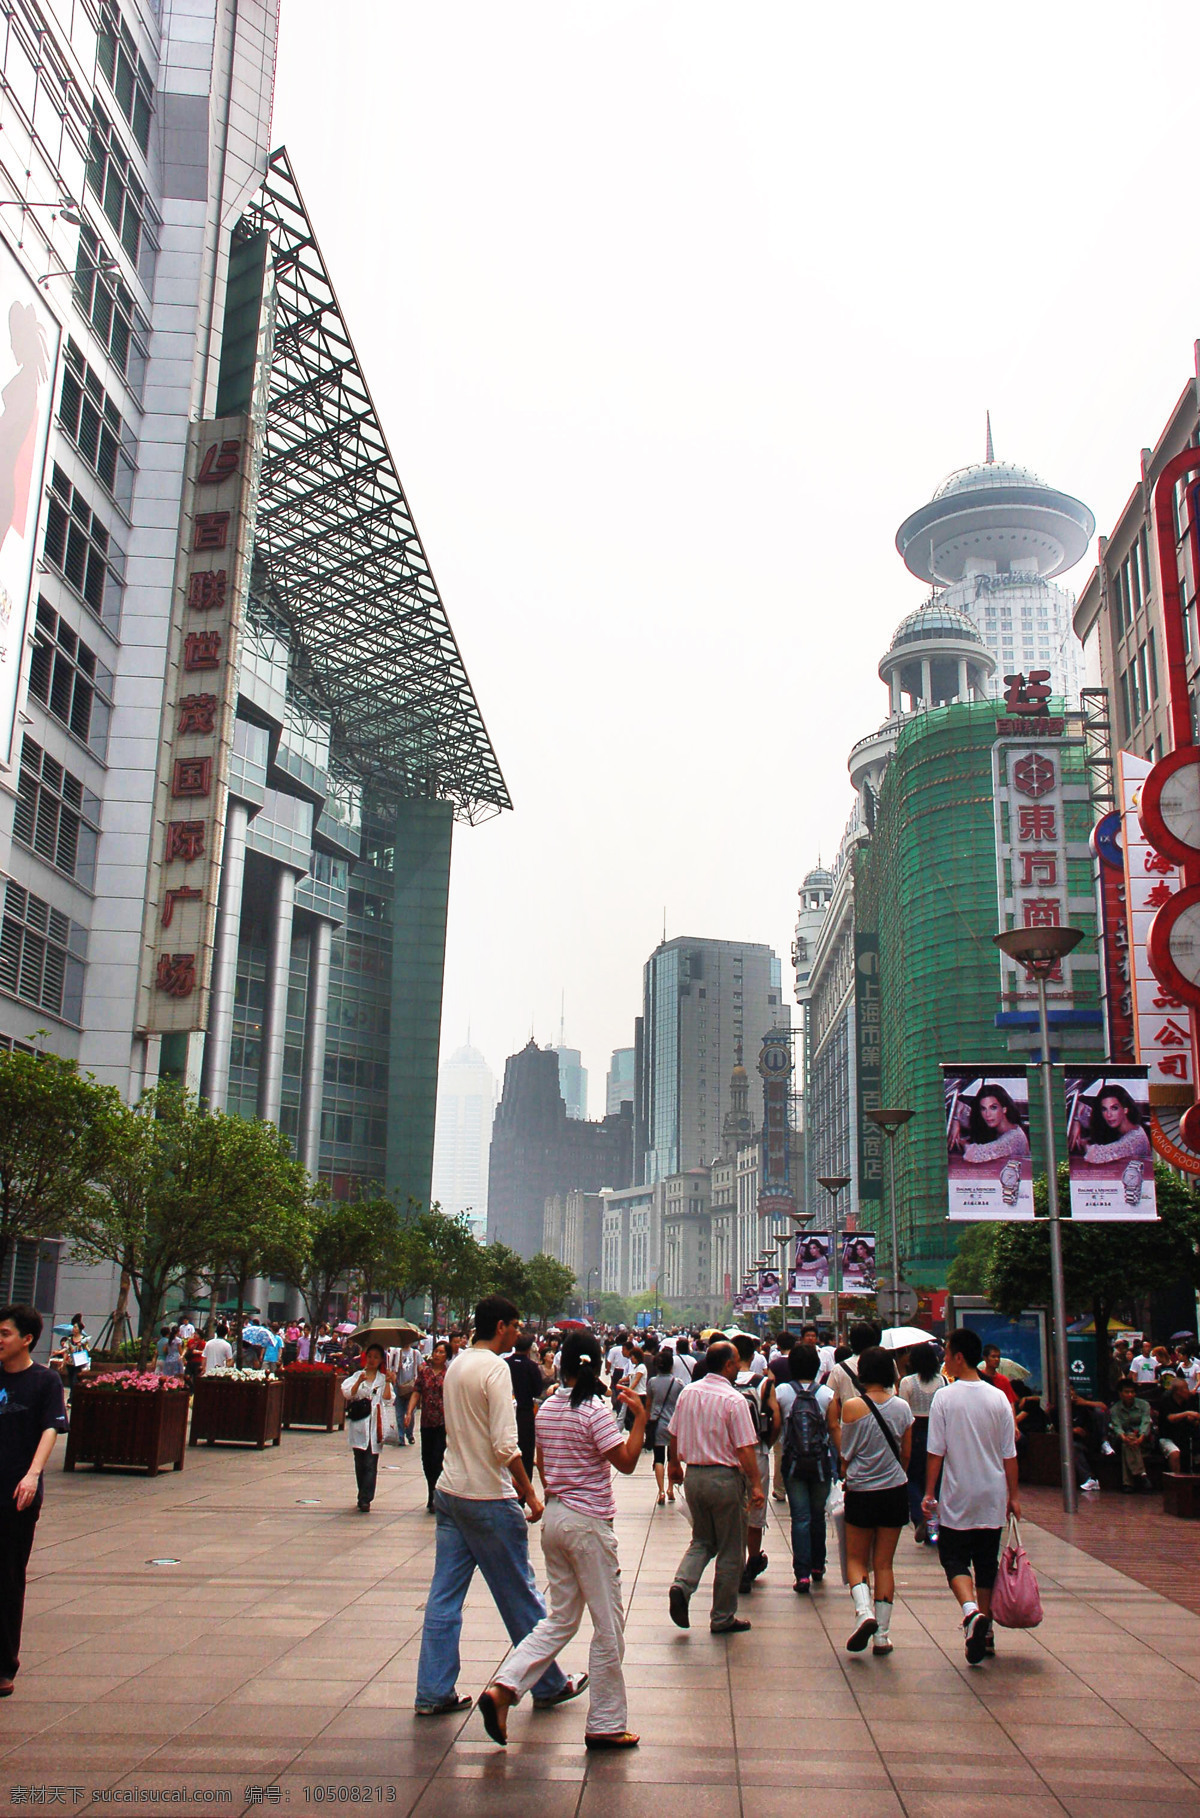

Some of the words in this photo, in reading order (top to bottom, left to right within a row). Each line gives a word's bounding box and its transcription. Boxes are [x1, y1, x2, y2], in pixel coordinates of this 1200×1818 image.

[156, 511, 230, 997] 百联世茂国际广场
[1152, 1128, 1173, 1154] KANG
